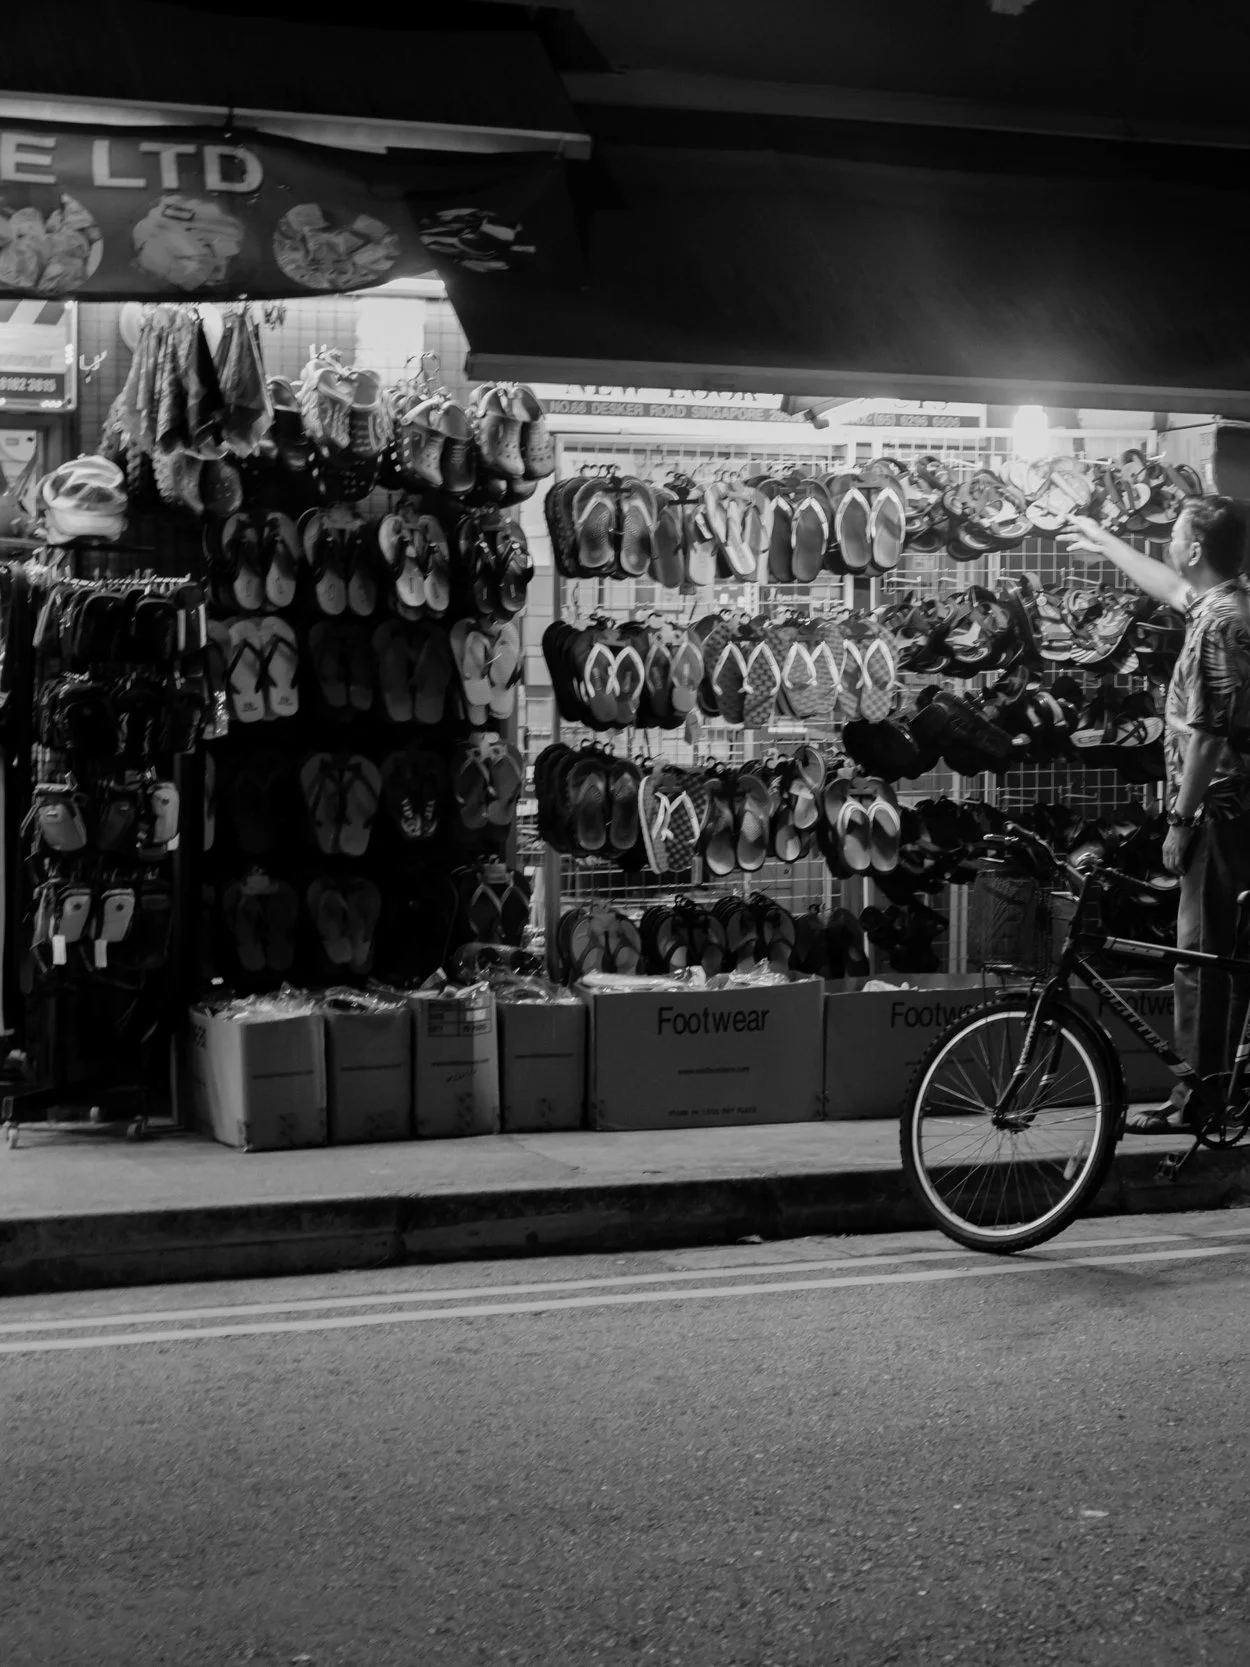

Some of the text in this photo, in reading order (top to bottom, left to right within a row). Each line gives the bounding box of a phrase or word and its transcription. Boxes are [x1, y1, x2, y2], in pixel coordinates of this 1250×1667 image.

[1, 131, 264, 194] E LTD
[591, 402, 645, 416] DESKER
[649, 404, 687, 418] ROAD
[691, 406, 764, 421] SINGAPORE
[657, 1006, 770, 1035] Footwear
